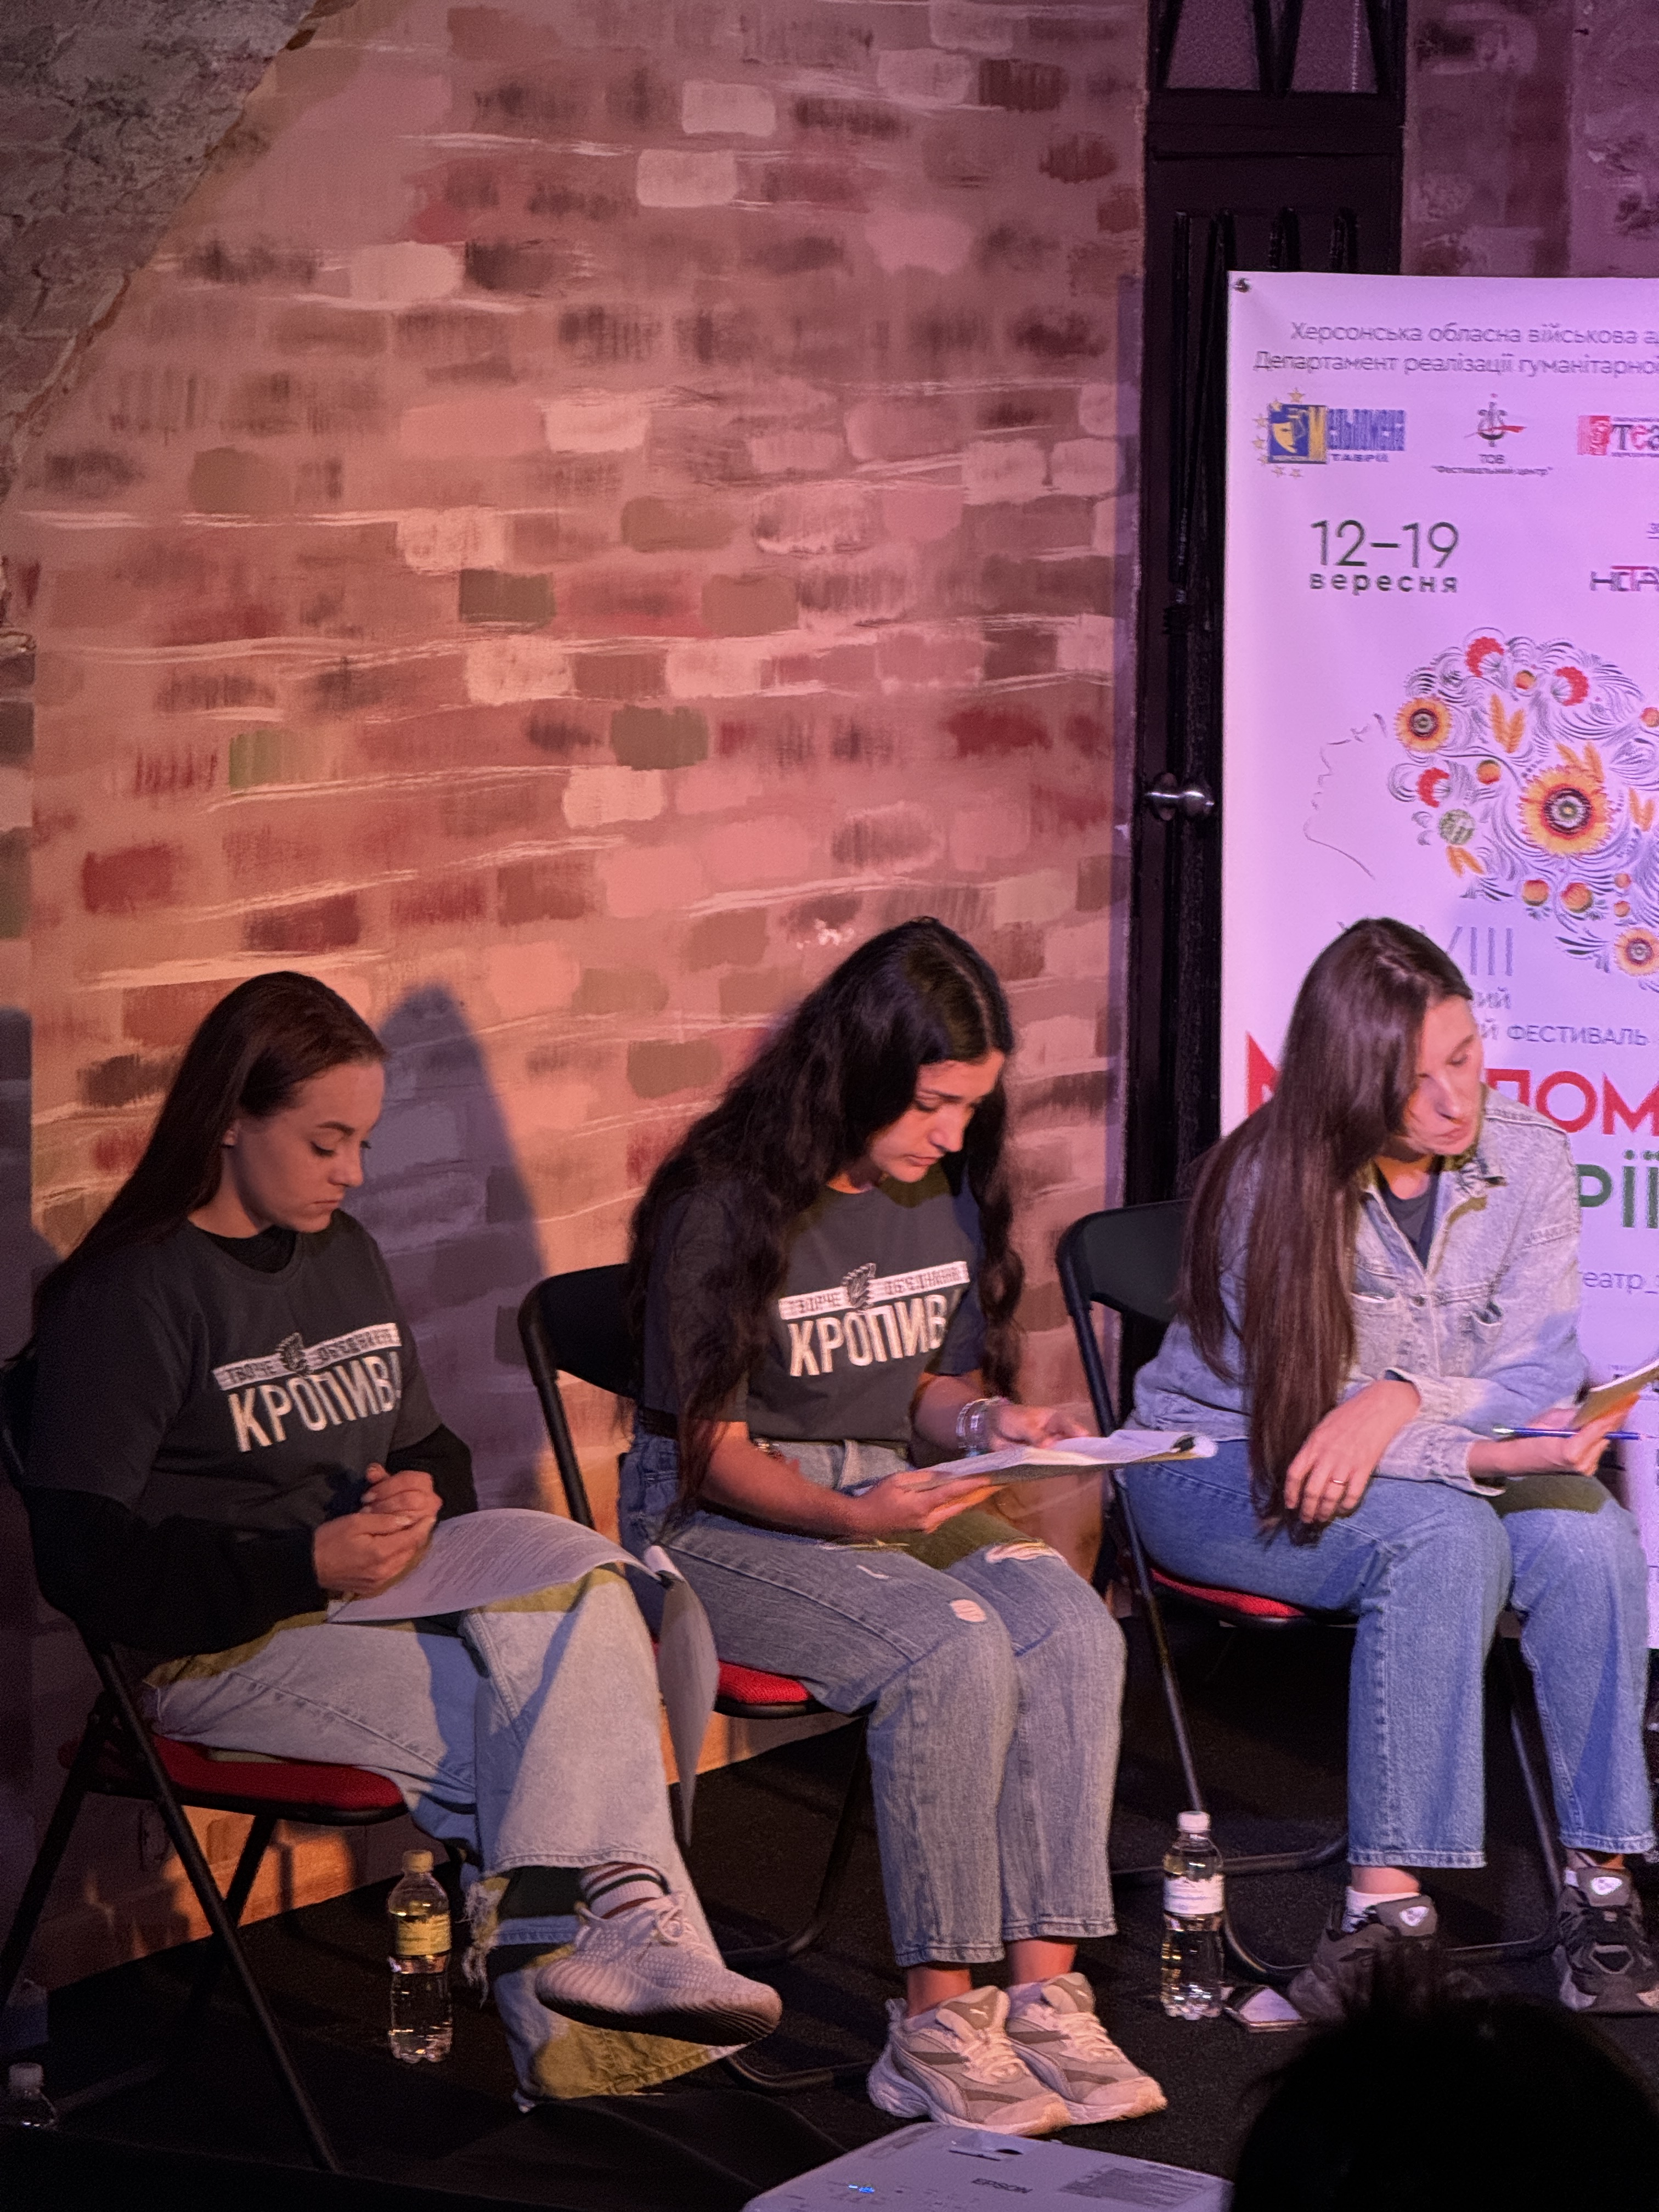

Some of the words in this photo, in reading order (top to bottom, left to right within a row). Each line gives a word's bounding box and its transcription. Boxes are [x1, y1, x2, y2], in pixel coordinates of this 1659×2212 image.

[1428, 321, 1521, 343] обласна
[1528, 323, 1637, 345] військова
[1252, 351, 1398, 374] Департамент
[1403, 353, 1516, 376] реалізації
[1308, 573, 1458, 596] вересня
[1506, 1024, 1647, 1046] ФЕСТИВАЛЬ
[787, 1290, 961, 1378] КРОПИВ
[971, 2177, 1034, 2194] EPSON
